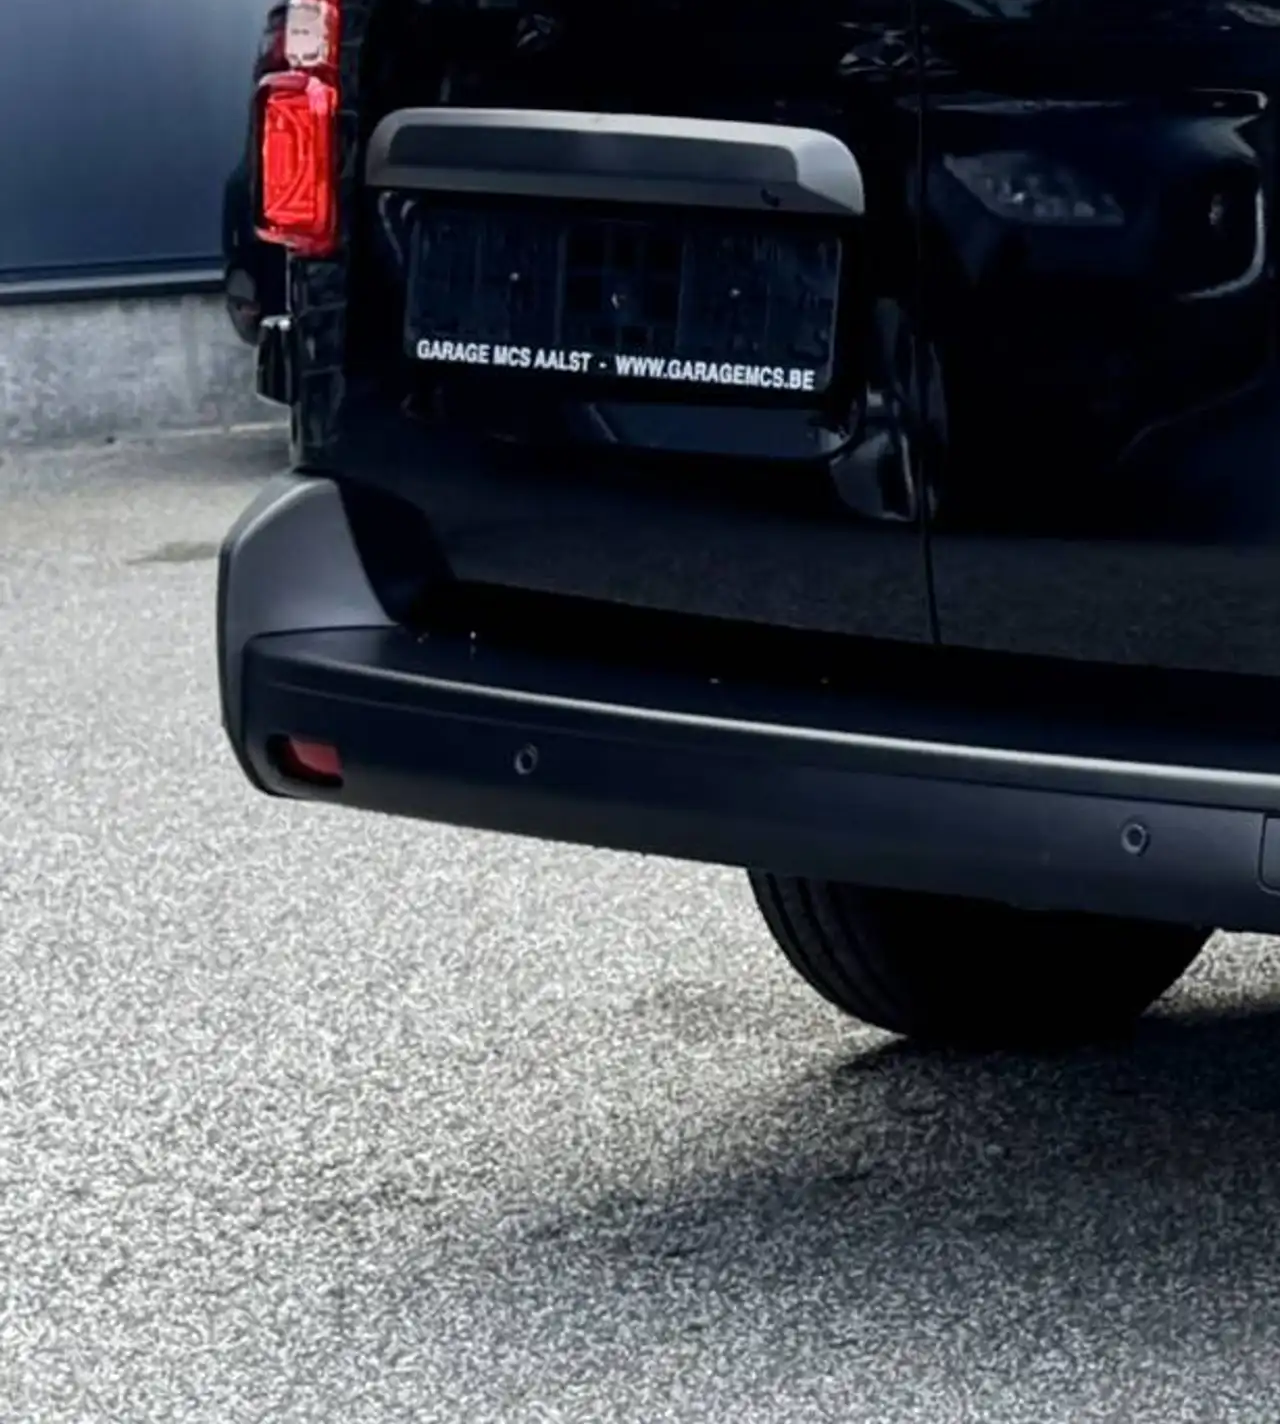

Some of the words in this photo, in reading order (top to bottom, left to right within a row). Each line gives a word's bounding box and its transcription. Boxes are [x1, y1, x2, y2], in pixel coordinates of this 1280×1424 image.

[417, 339, 491, 364] GARAGE
[493, 344, 532, 368] MCS
[534, 349, 592, 373] AALST
[615, 354, 815, 391] WWW.GARAGEMCS.BE
